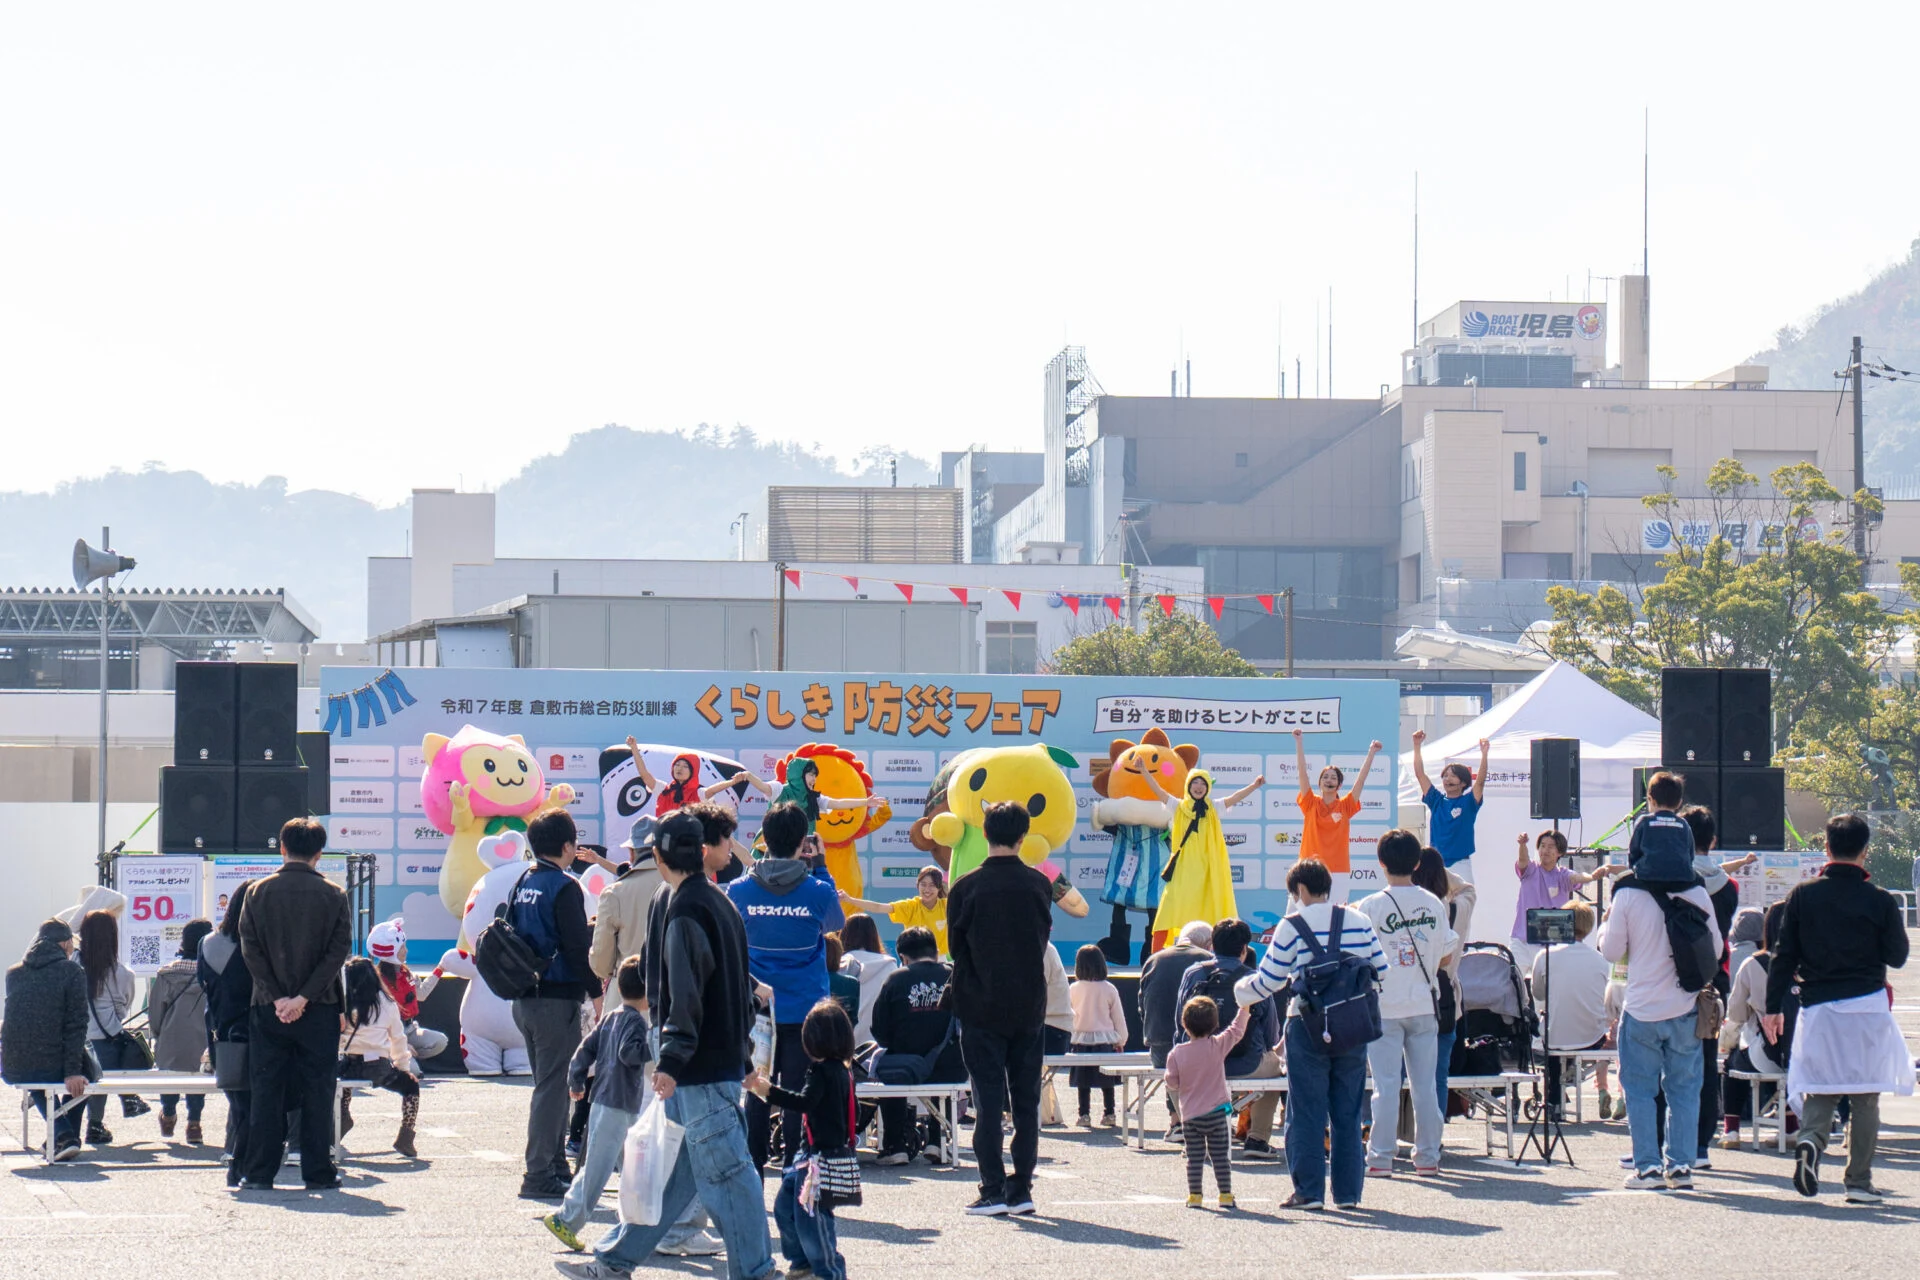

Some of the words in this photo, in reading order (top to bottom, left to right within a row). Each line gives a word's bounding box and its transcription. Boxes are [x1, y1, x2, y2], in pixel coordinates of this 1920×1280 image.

[1491, 314, 1520, 324] BOAT
[1517, 314, 1574, 338] 児島
[1488, 325, 1518, 336] RACE
[529, 700, 678, 717] 倉敷市総合防災訓練
[695, 681, 1061, 737] くらしき防災フェア
[1114, 699, 1136, 707] あなた
[132, 895, 174, 921] 50
[747, 904, 811, 917] セキスイハイム
[1379, 911, 1437, 935] Someday
